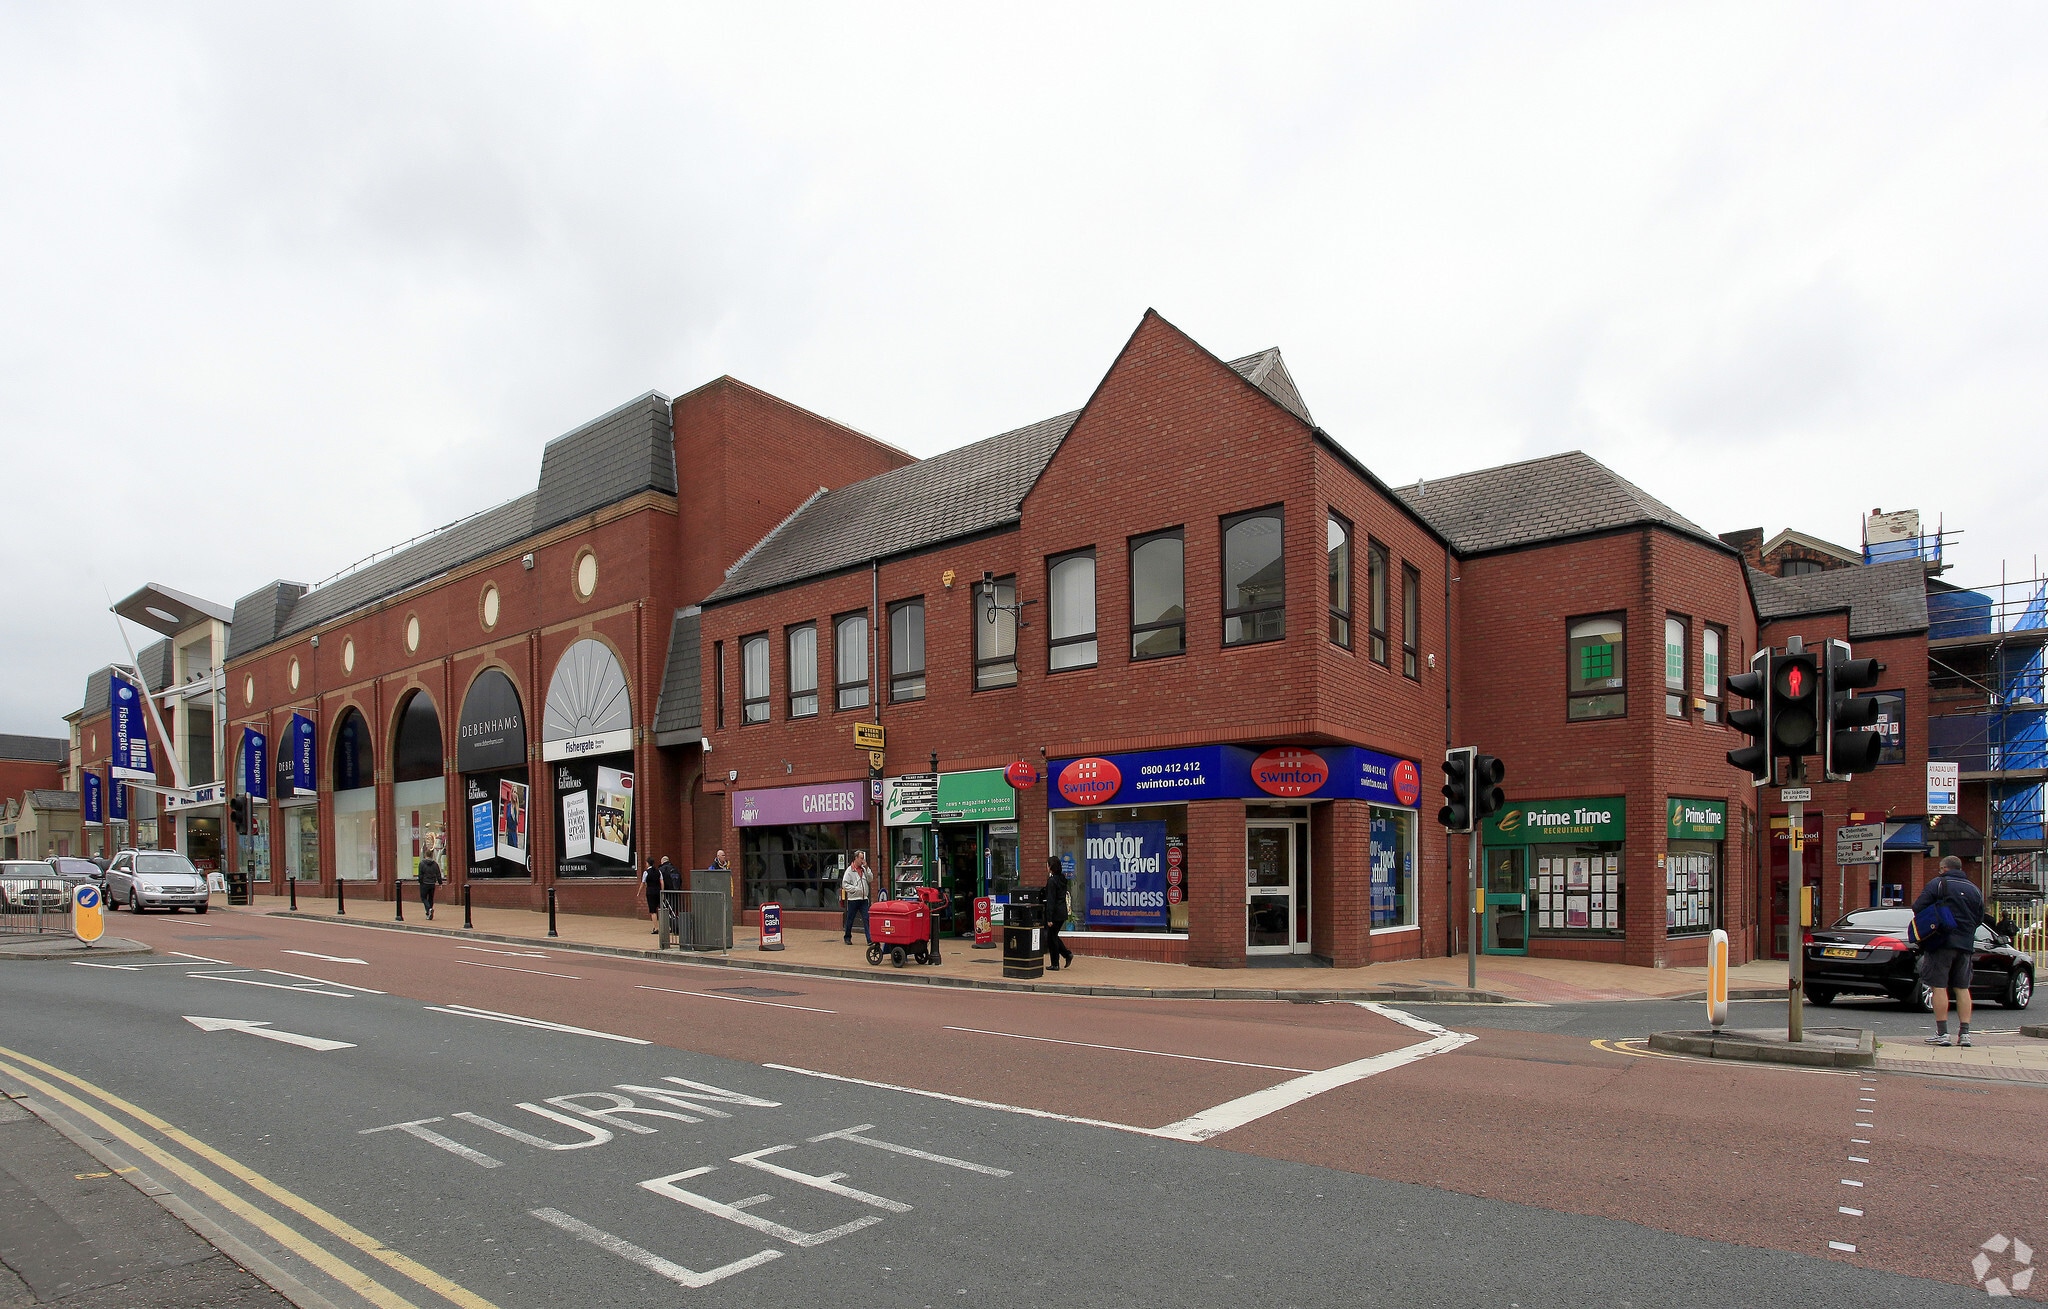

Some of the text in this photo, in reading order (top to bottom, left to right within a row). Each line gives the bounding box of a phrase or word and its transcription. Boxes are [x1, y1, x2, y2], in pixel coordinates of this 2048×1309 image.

[118, 707, 129, 751] Fishergate
[462, 715, 518, 738] DEBENHAMS
[565, 740, 595, 753] Fishergate
[303, 738, 311, 775] Fishergate
[253, 750, 261, 784] Fishergate
[279, 760, 295, 772] DEBEN
[1141, 761, 1201, 775] 0800 412 412
[1362, 763, 1372, 774] 0800
[558, 778, 582, 789] fabulous
[1136, 775, 1206, 790] swinton.co.uk
[1260, 770, 1322, 784] swinton
[1360, 776, 1388, 790] swinton.co.uk
[1930, 777, 1957, 787] TO LET
[1064, 779, 1115, 794] swinton
[802, 791, 855, 813] CAREERS
[962, 799, 987, 808] magazines
[740, 809, 759, 821] ARMY
[1527, 807, 1611, 826] Prime Time
[1685, 807, 1722, 824] Prime Time
[1543, 826, 1594, 835] RECRUITMENT
[1086, 832, 1143, 860] motor
[1119, 852, 1160, 873] travel
[1380, 846, 1396, 869] rock
[1091, 865, 1137, 889] home
[1103, 887, 1164, 907] business
[765, 918, 780, 926] cash
[358, 1075, 782, 1170] TURN
[527, 1123, 1013, 1288] LEFT
